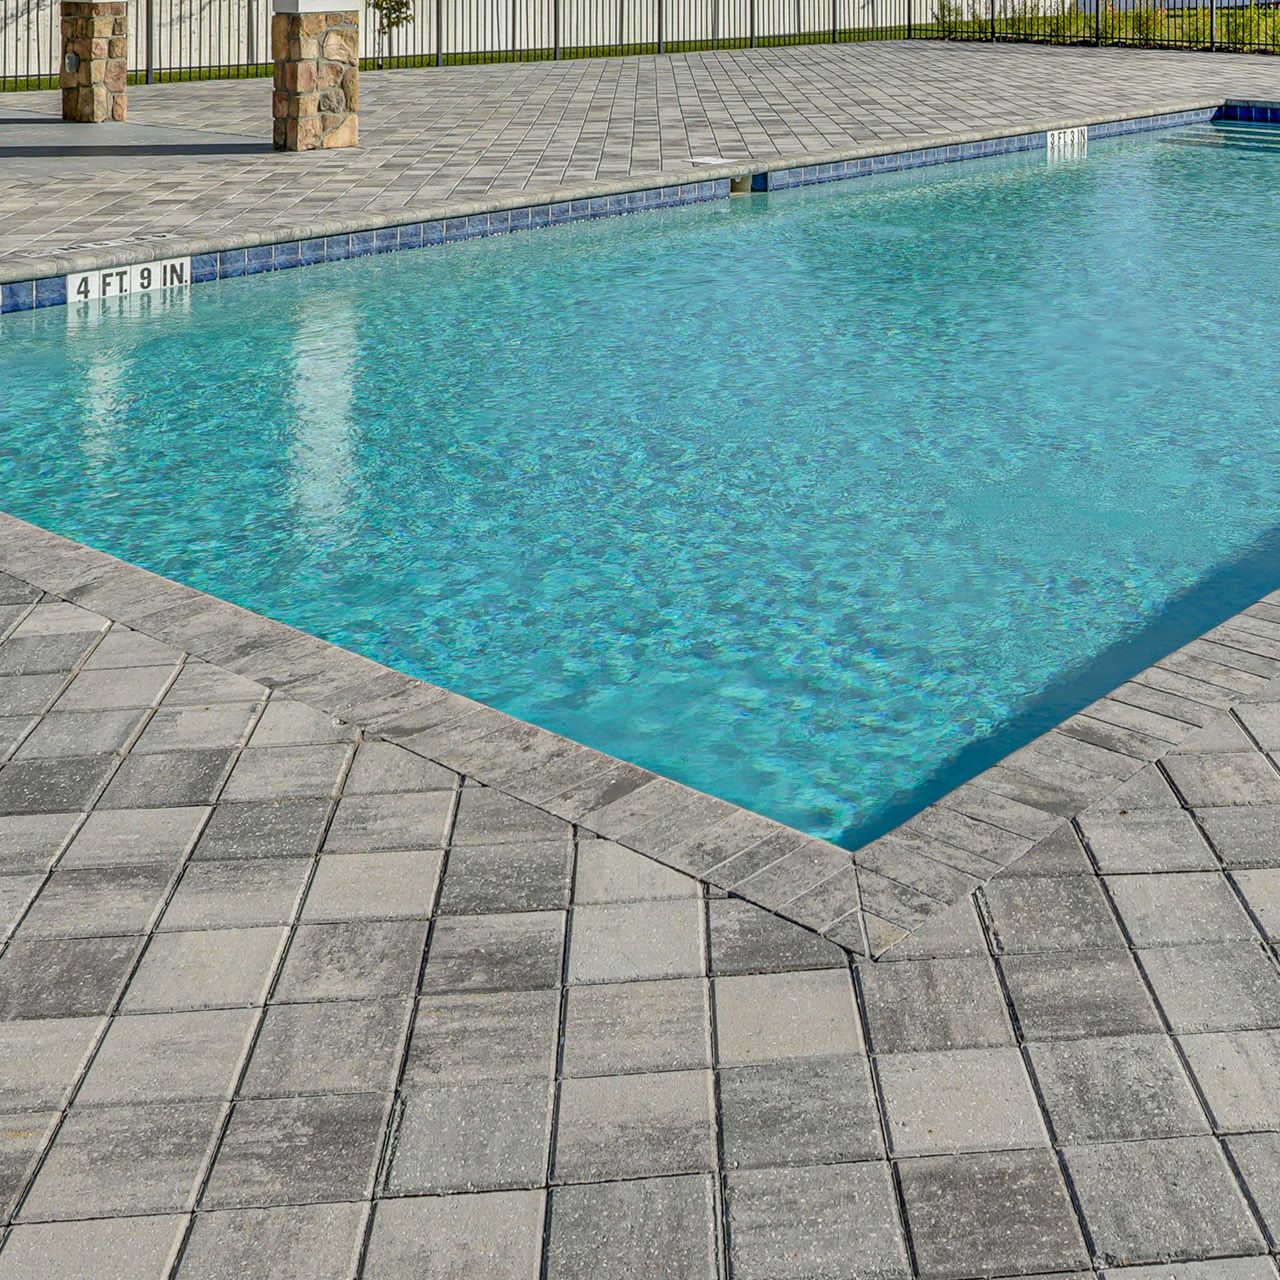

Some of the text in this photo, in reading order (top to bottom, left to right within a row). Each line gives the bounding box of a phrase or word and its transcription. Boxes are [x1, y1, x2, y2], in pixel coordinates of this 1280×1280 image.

[1050, 133, 1055, 146] 3
[1070, 130, 1075, 144] 3
[76, 262, 188, 300] 4 FT. 9 IN.
